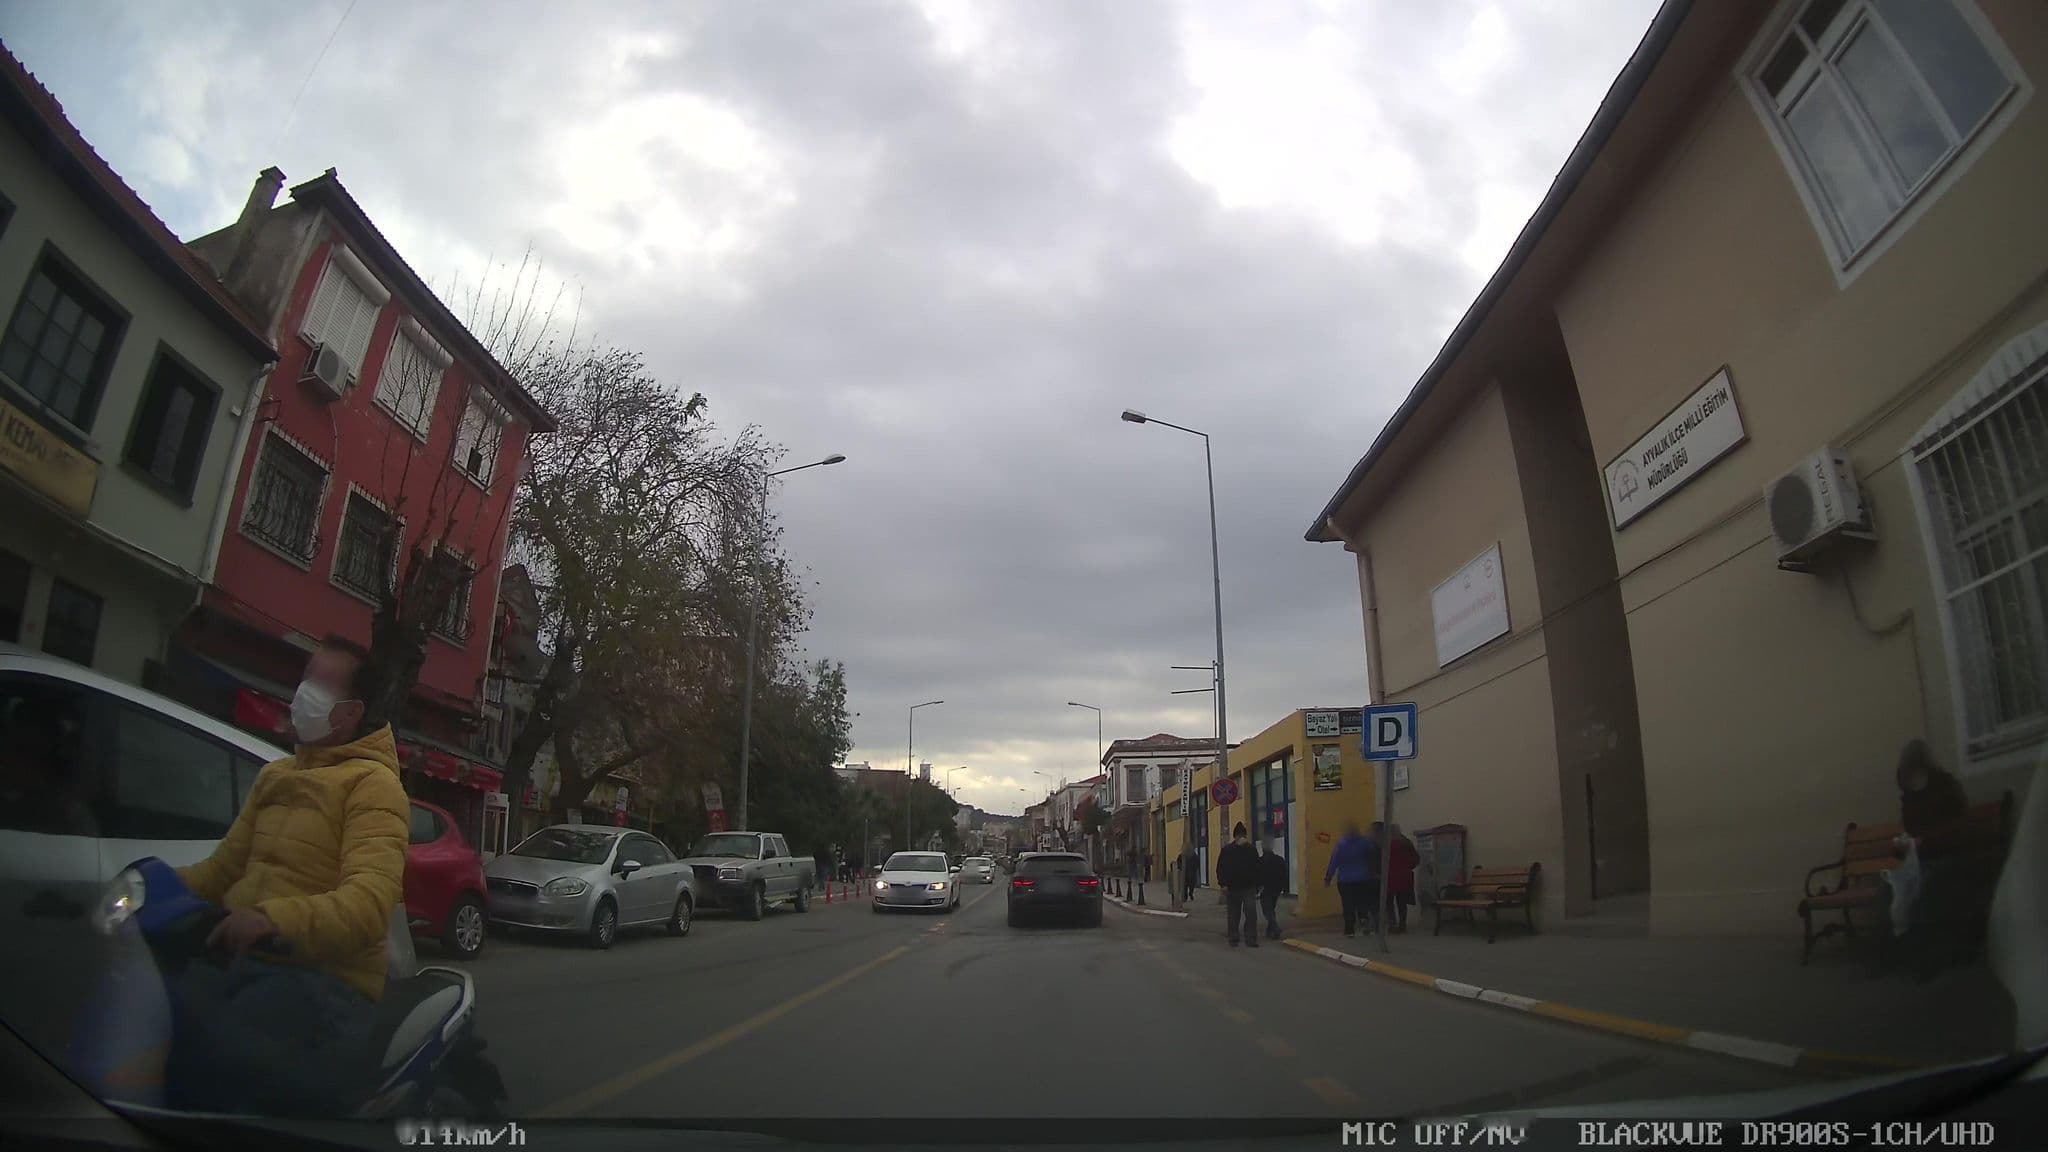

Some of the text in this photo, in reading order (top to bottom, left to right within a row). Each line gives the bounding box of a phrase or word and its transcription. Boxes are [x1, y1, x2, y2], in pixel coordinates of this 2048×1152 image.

[1642, 387, 1729, 468] AYVALIK İLÇE MİLLİ EĞİTİM
[1647, 447, 1689, 490] MÜDÜRLÜĞÜ
[1307, 714, 1326, 725] Beyaz
[1378, 716, 1402, 747] D
